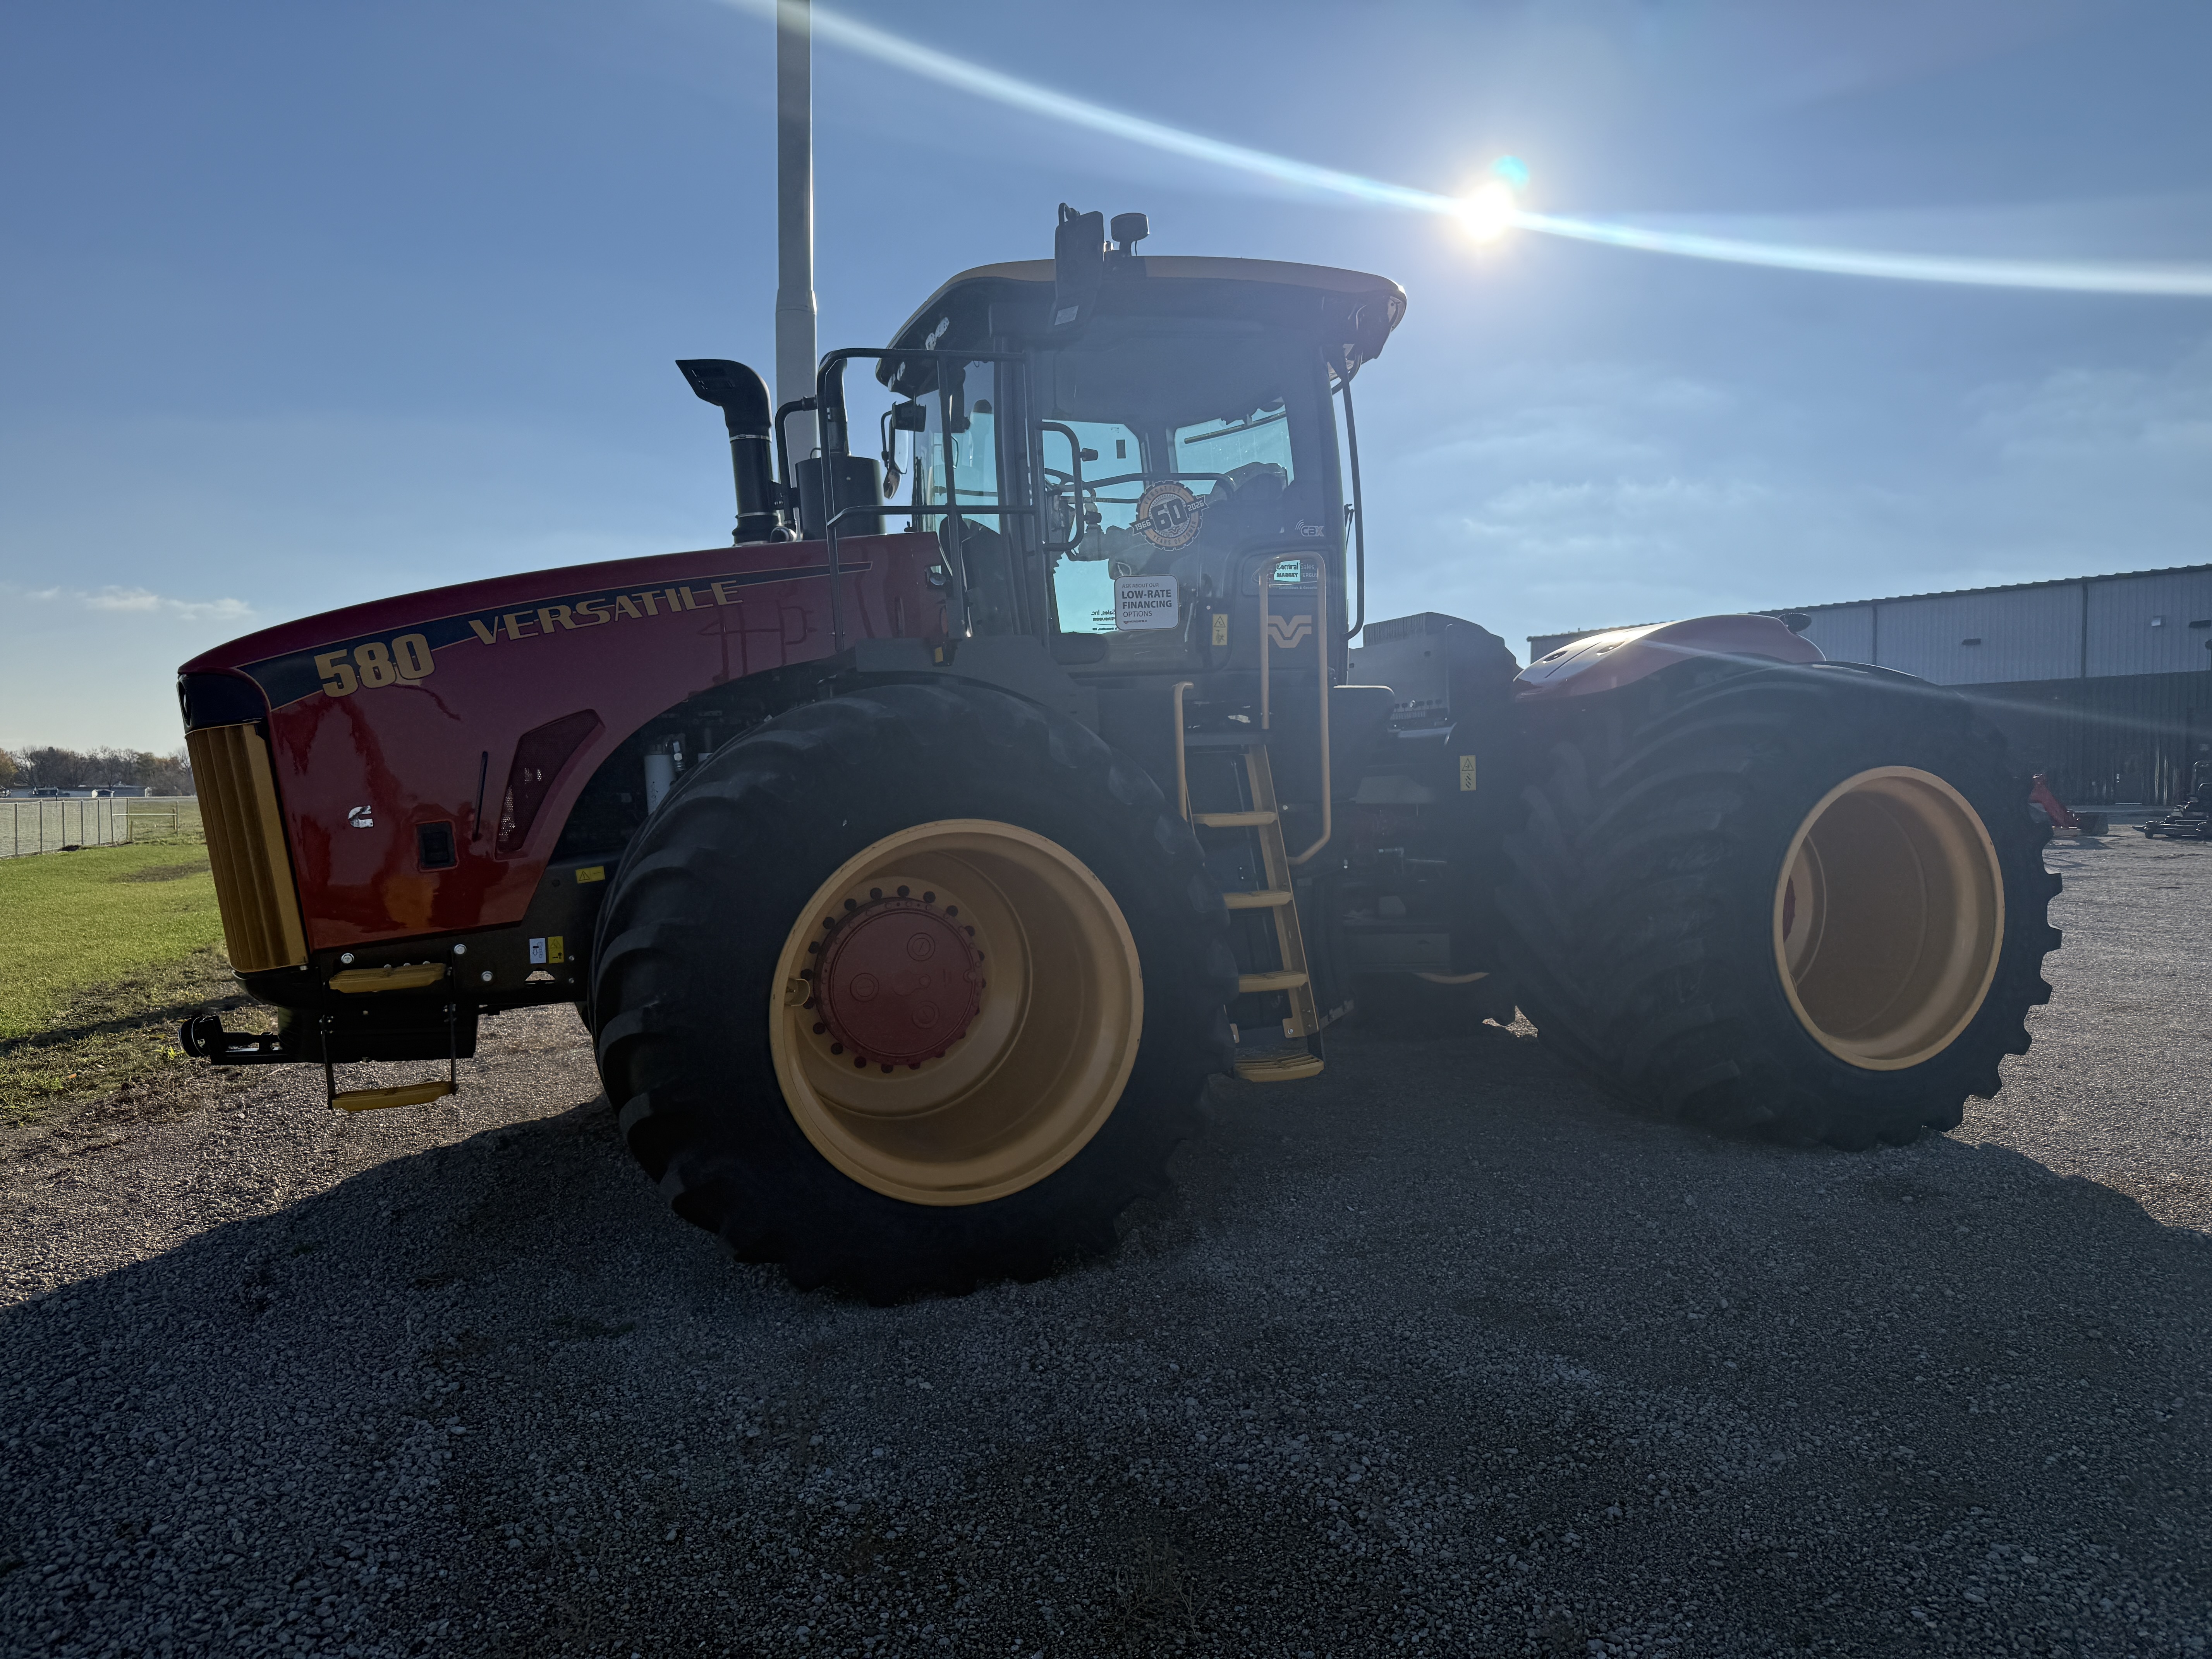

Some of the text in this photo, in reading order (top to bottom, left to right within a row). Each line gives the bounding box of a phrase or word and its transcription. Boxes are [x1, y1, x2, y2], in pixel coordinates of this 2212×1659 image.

[1144, 486, 1181, 504] VERSATILE
[1187, 500, 1204, 511] 2026
[1151, 498, 1187, 531] 60
[1135, 520, 1151, 531] 1966
[1153, 535, 1171, 545] YEARS
[1183, 521, 1197, 540] POWER
[1276, 562, 1298, 570] Central
[1122, 589, 1171, 599] LOW-RATE
[1122, 600, 1172, 609] FINANCING
[468, 580, 743, 645] VERSATILE
[314, 633, 436, 697] 580
